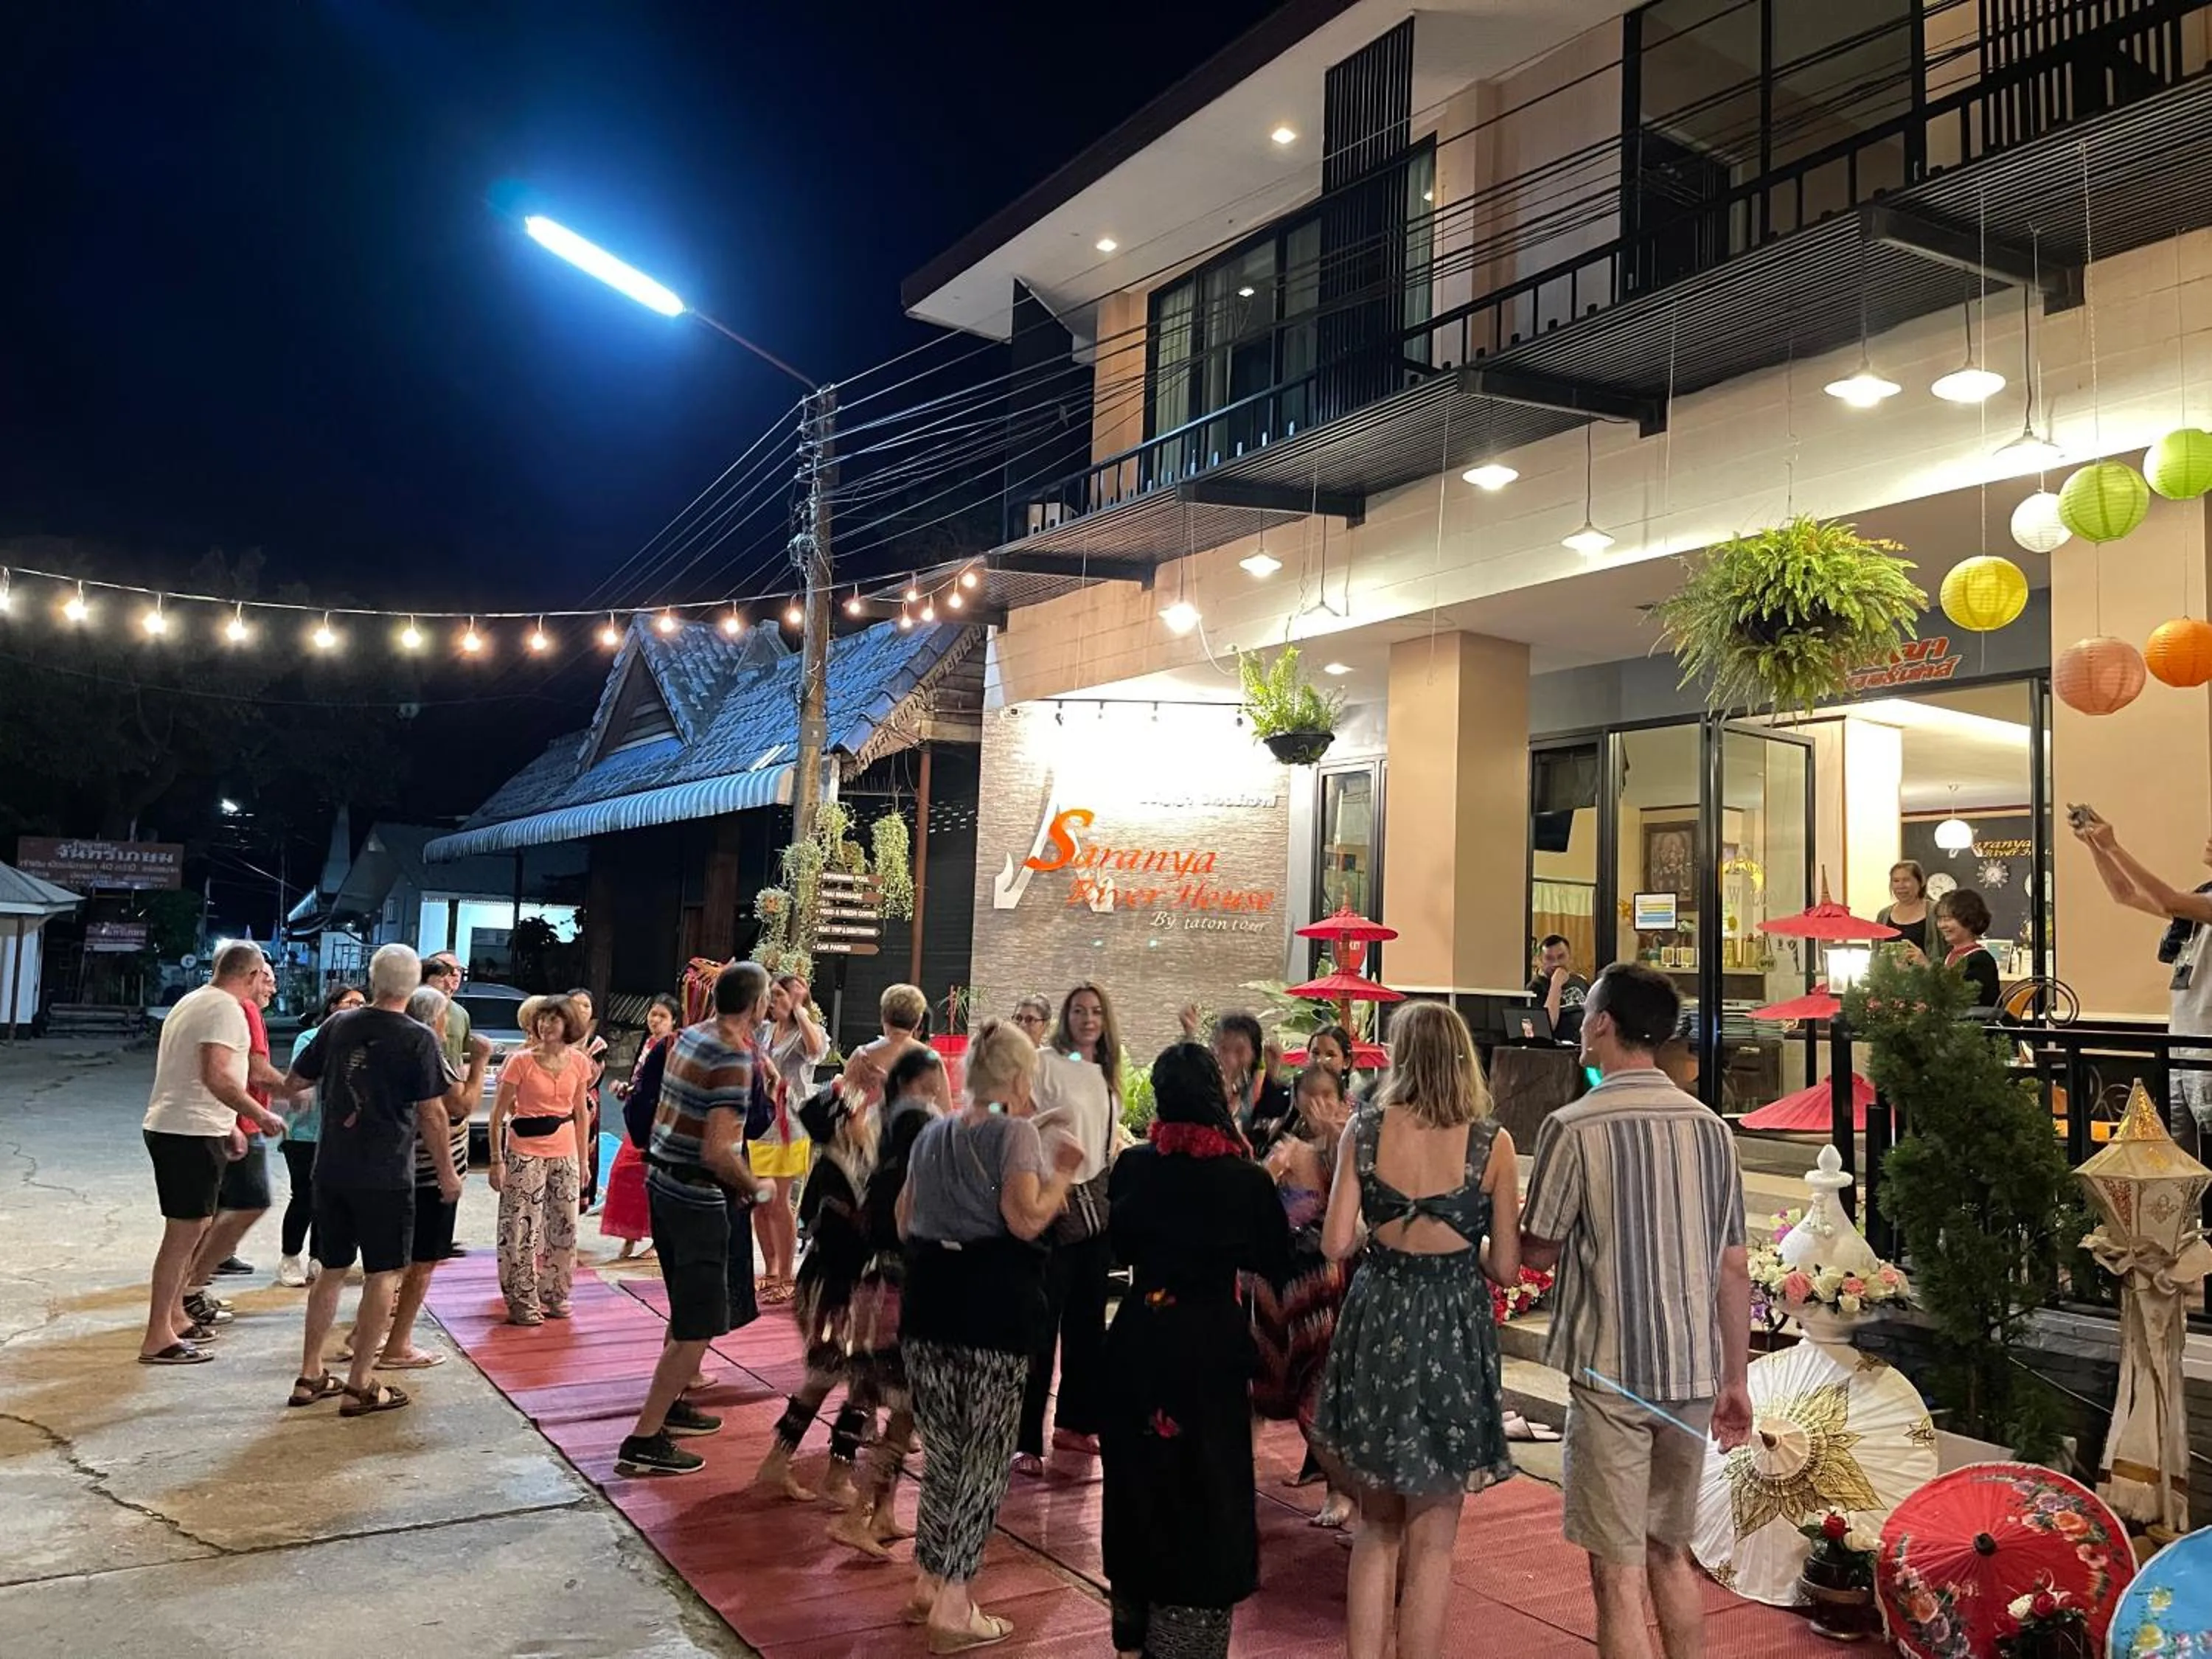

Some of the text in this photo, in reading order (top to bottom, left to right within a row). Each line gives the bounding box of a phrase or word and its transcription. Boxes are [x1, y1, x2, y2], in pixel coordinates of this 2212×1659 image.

[1023, 808, 1217, 883] Saranya
[1972, 839, 2032, 850] aranya
[1066, 879, 1275, 912] River House
[1150, 911, 1176, 931] By
